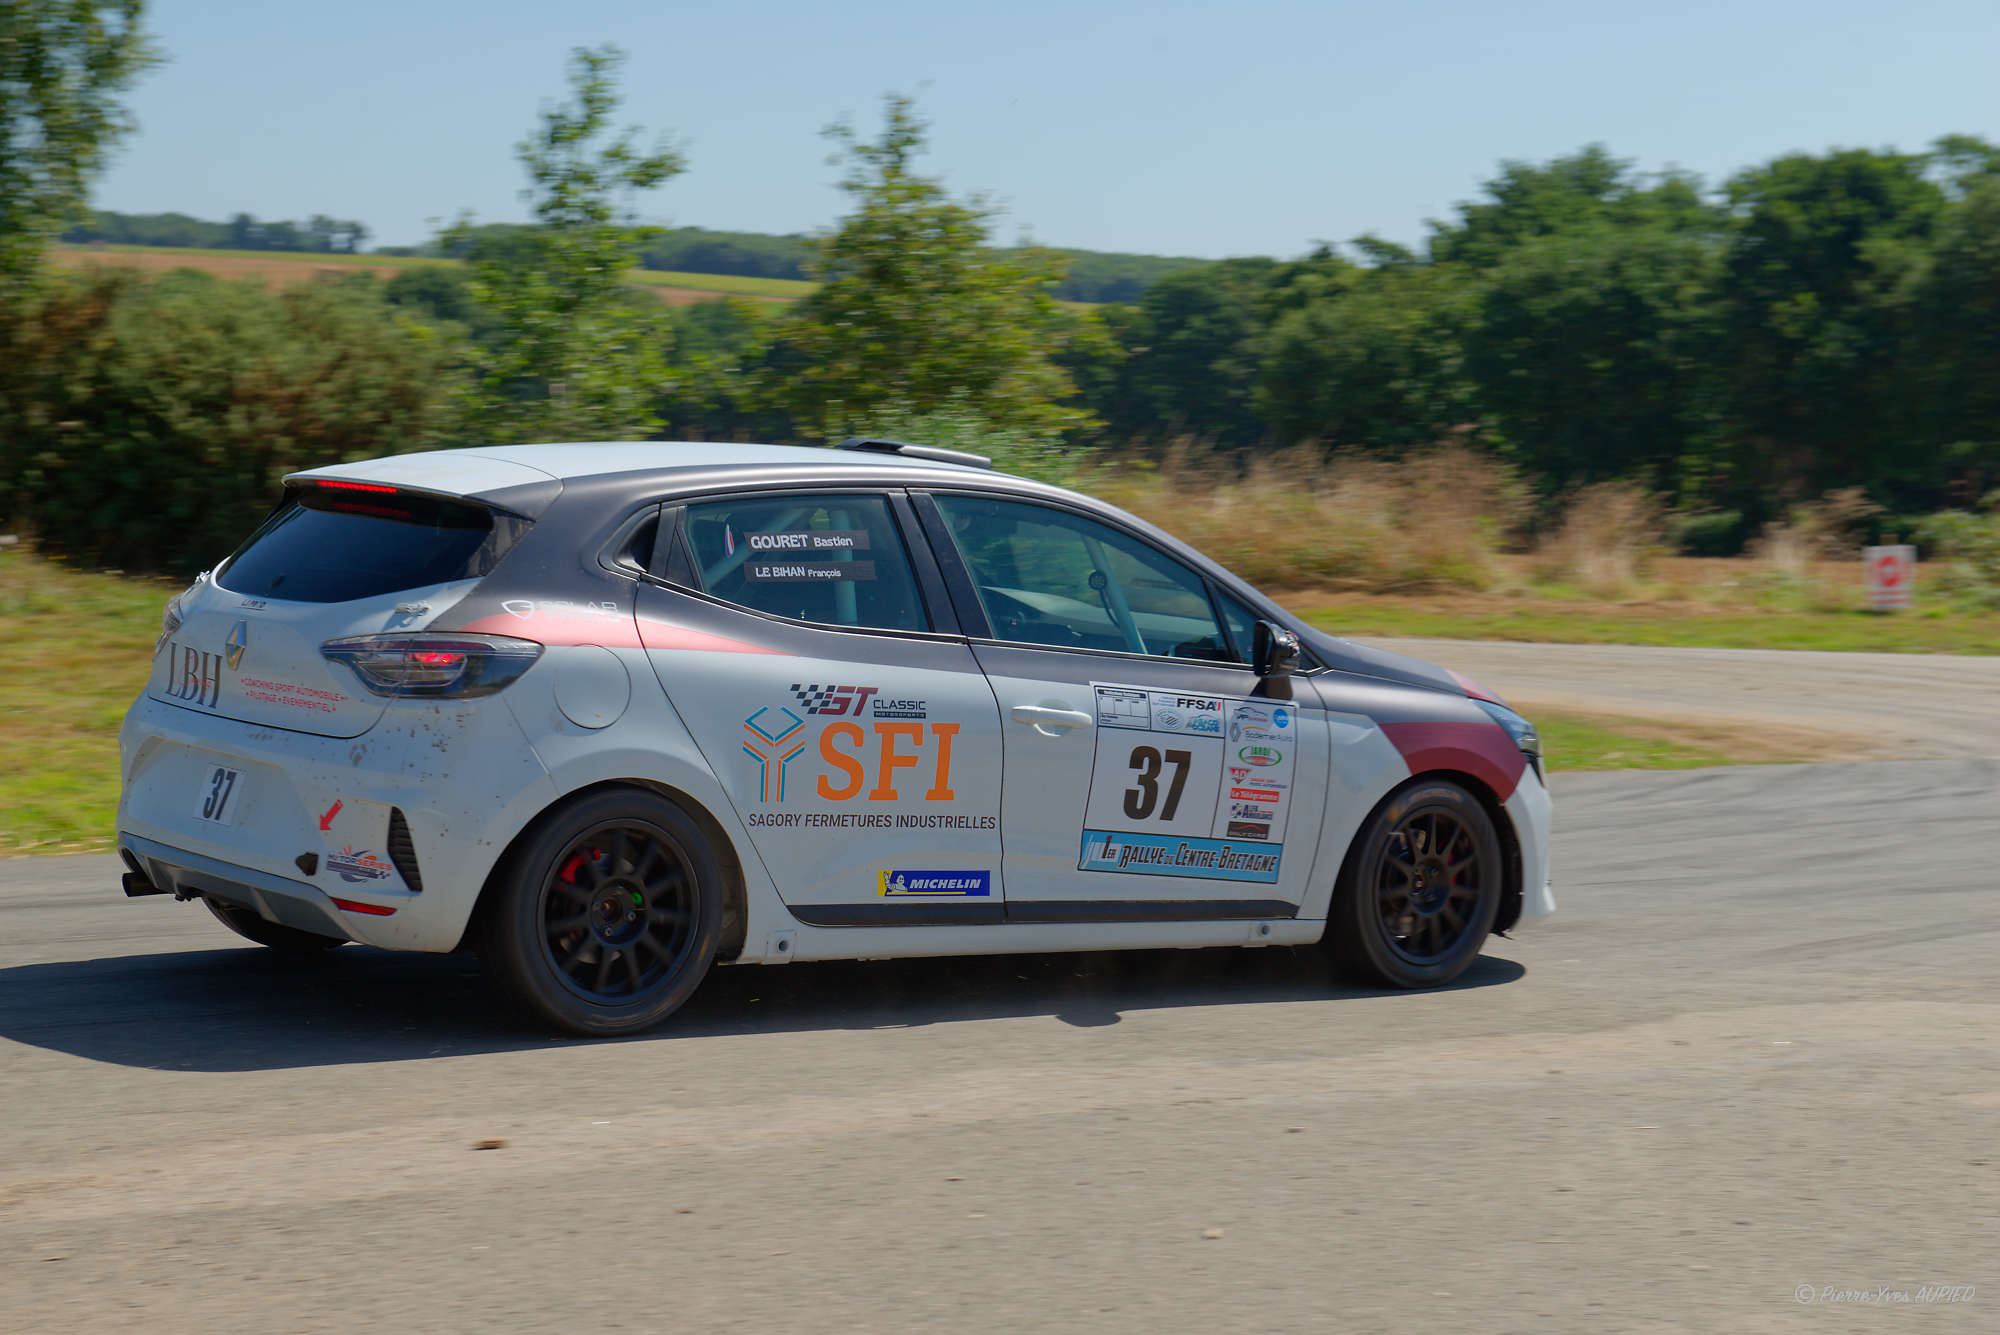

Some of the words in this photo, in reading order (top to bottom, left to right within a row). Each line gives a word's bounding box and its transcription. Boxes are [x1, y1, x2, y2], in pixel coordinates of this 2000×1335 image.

[750, 534, 809, 550] GOURET
[813, 536, 854, 548] Bastien
[755, 567, 771, 578] LE
[772, 566, 806, 577] BIHAN
[807, 569, 842, 579] François
[165, 642, 223, 710] LBH
[274, 682, 295, 692] SPORT
[296, 686, 340, 702] AUTOMOBILE
[873, 699, 927, 711] CLASSIC
[1177, 698, 1217, 712] FFSA
[817, 721, 961, 801] SFI
[1123, 745, 1192, 821] 37
[203, 767, 238, 821] 37
[749, 813, 802, 828] SAGORY
[804, 814, 893, 828] FERMETURES
[895, 815, 997, 830] INDUSTRIELLES
[1118, 845, 1166, 868] RALLYE
[1175, 842, 1279, 873] CENTRE-BRETAGNE
[909, 878, 982, 889] MICHELIN
